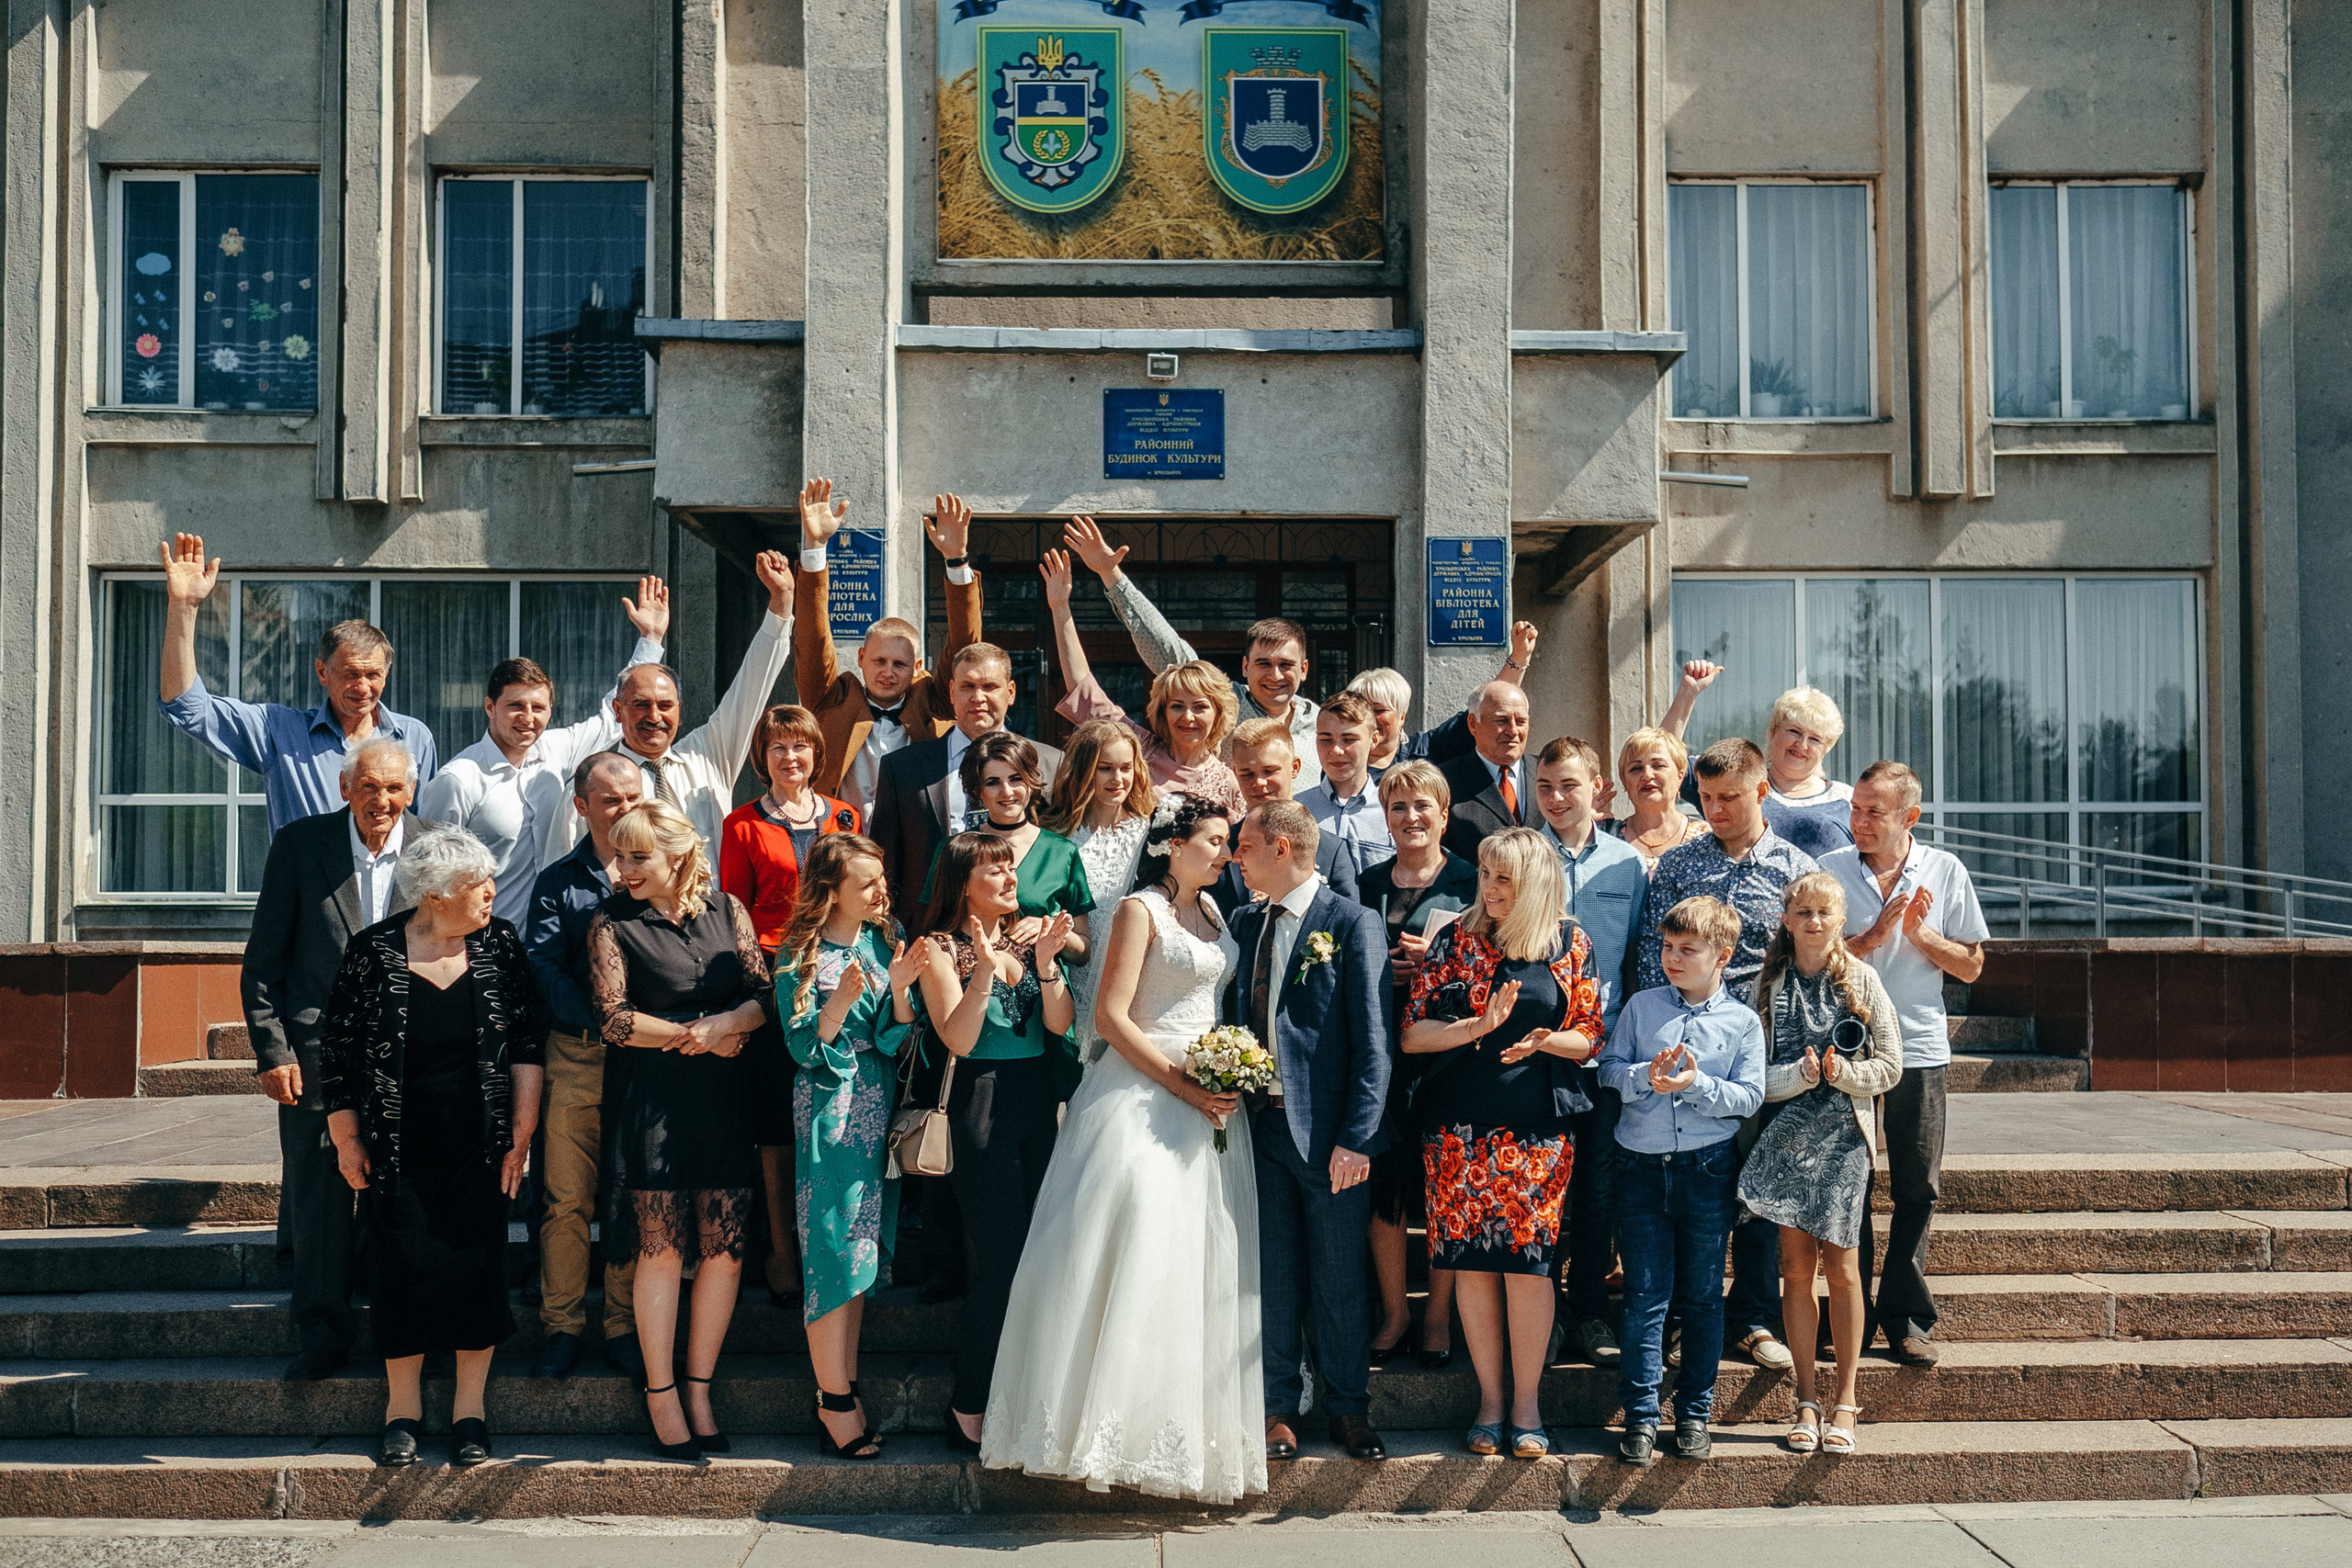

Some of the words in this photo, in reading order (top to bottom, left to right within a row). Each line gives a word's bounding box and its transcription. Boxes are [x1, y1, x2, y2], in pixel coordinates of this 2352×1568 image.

[1135, 438, 1194, 450] РАЙОННИЙ
[1107, 454, 1158, 464] БУДИНОК
[1167, 454, 1222, 464] КУЛЬТУРИ
[829, 580, 870, 591] ЙОННА
[830, 592, 876, 601] ЛІОТЕКА
[1442, 587, 1493, 597] РАЙОННА
[833, 603, 854, 612] ДЛЯ
[1435, 599, 1499, 608] БІБЛІОТЕКА
[830, 613, 873, 622] РОСЛИХ
[1457, 610, 1479, 619] ДЛЯ
[1451, 617, 1485, 629] ДІТЕЙ
